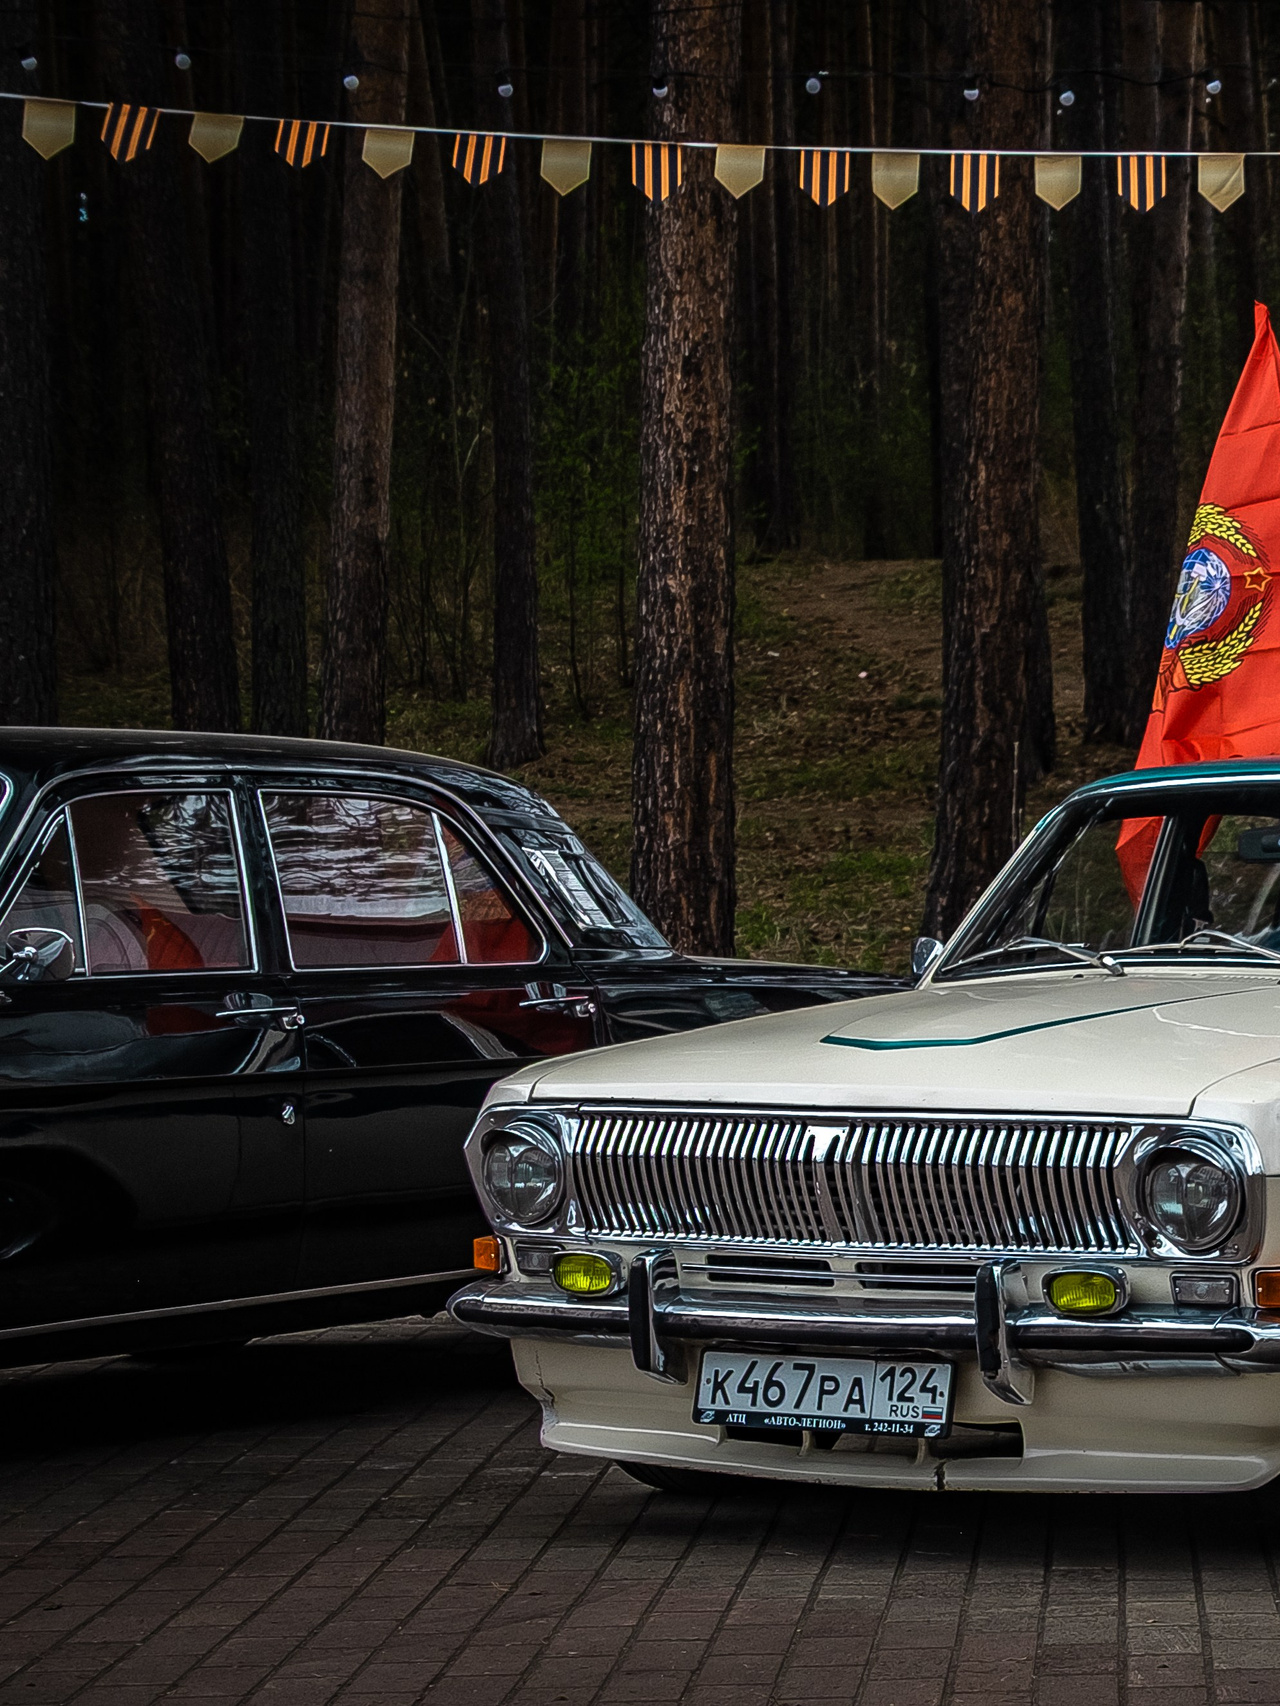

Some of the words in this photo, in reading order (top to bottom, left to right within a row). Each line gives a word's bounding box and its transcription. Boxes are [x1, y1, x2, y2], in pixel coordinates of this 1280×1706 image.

[709, 1360, 866, 1414] К467РА
[879, 1366, 937, 1405] 124
[889, 1404, 920, 1419] RUS
[726, 1413, 747, 1425] АТЦ
[873, 1422, 914, 1434] 242-11-34
